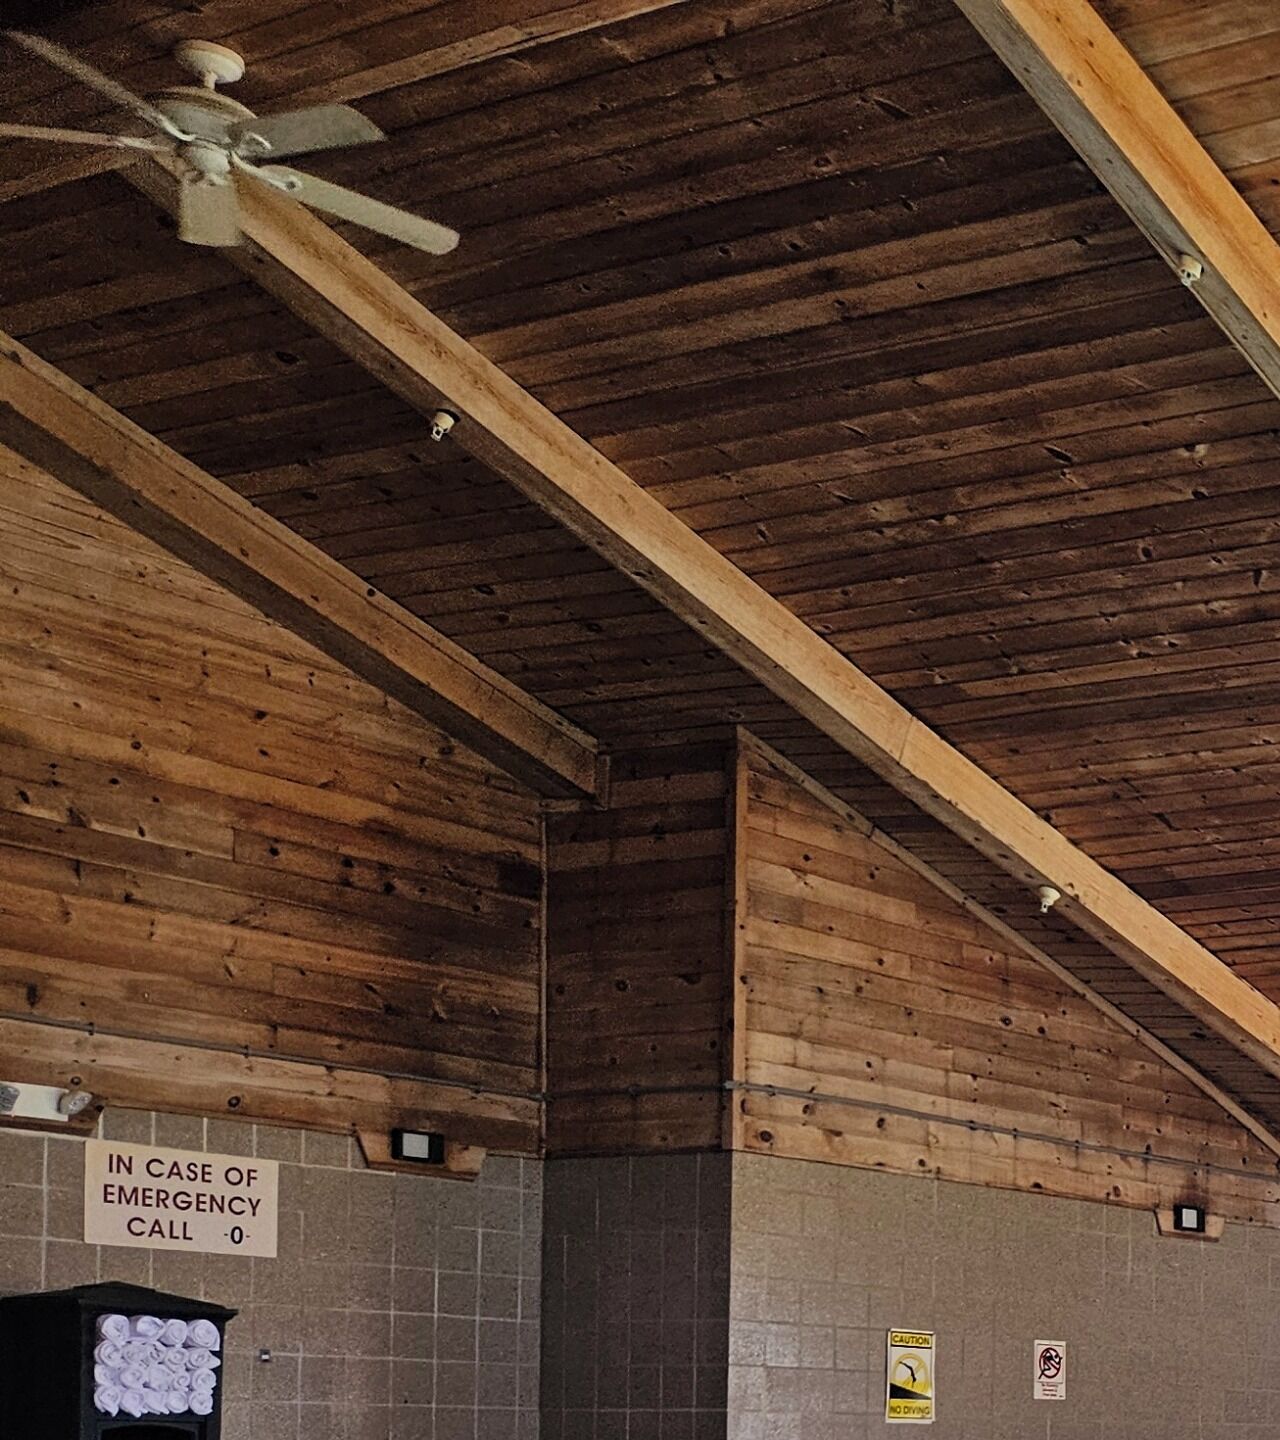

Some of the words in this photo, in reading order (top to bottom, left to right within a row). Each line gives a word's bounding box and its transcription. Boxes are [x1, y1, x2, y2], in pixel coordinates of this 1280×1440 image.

[108, 1153, 133, 1175] IN
[146, 1158, 212, 1183] CASE
[225, 1167, 258, 1187] OF
[103, 1184, 261, 1217] EMERGENCY
[127, 1217, 193, 1240] CALL
[892, 1334, 930, 1345] CAUTION
[889, 1405, 902, 1415] NO
[903, 1405, 930, 1416] DIVING
